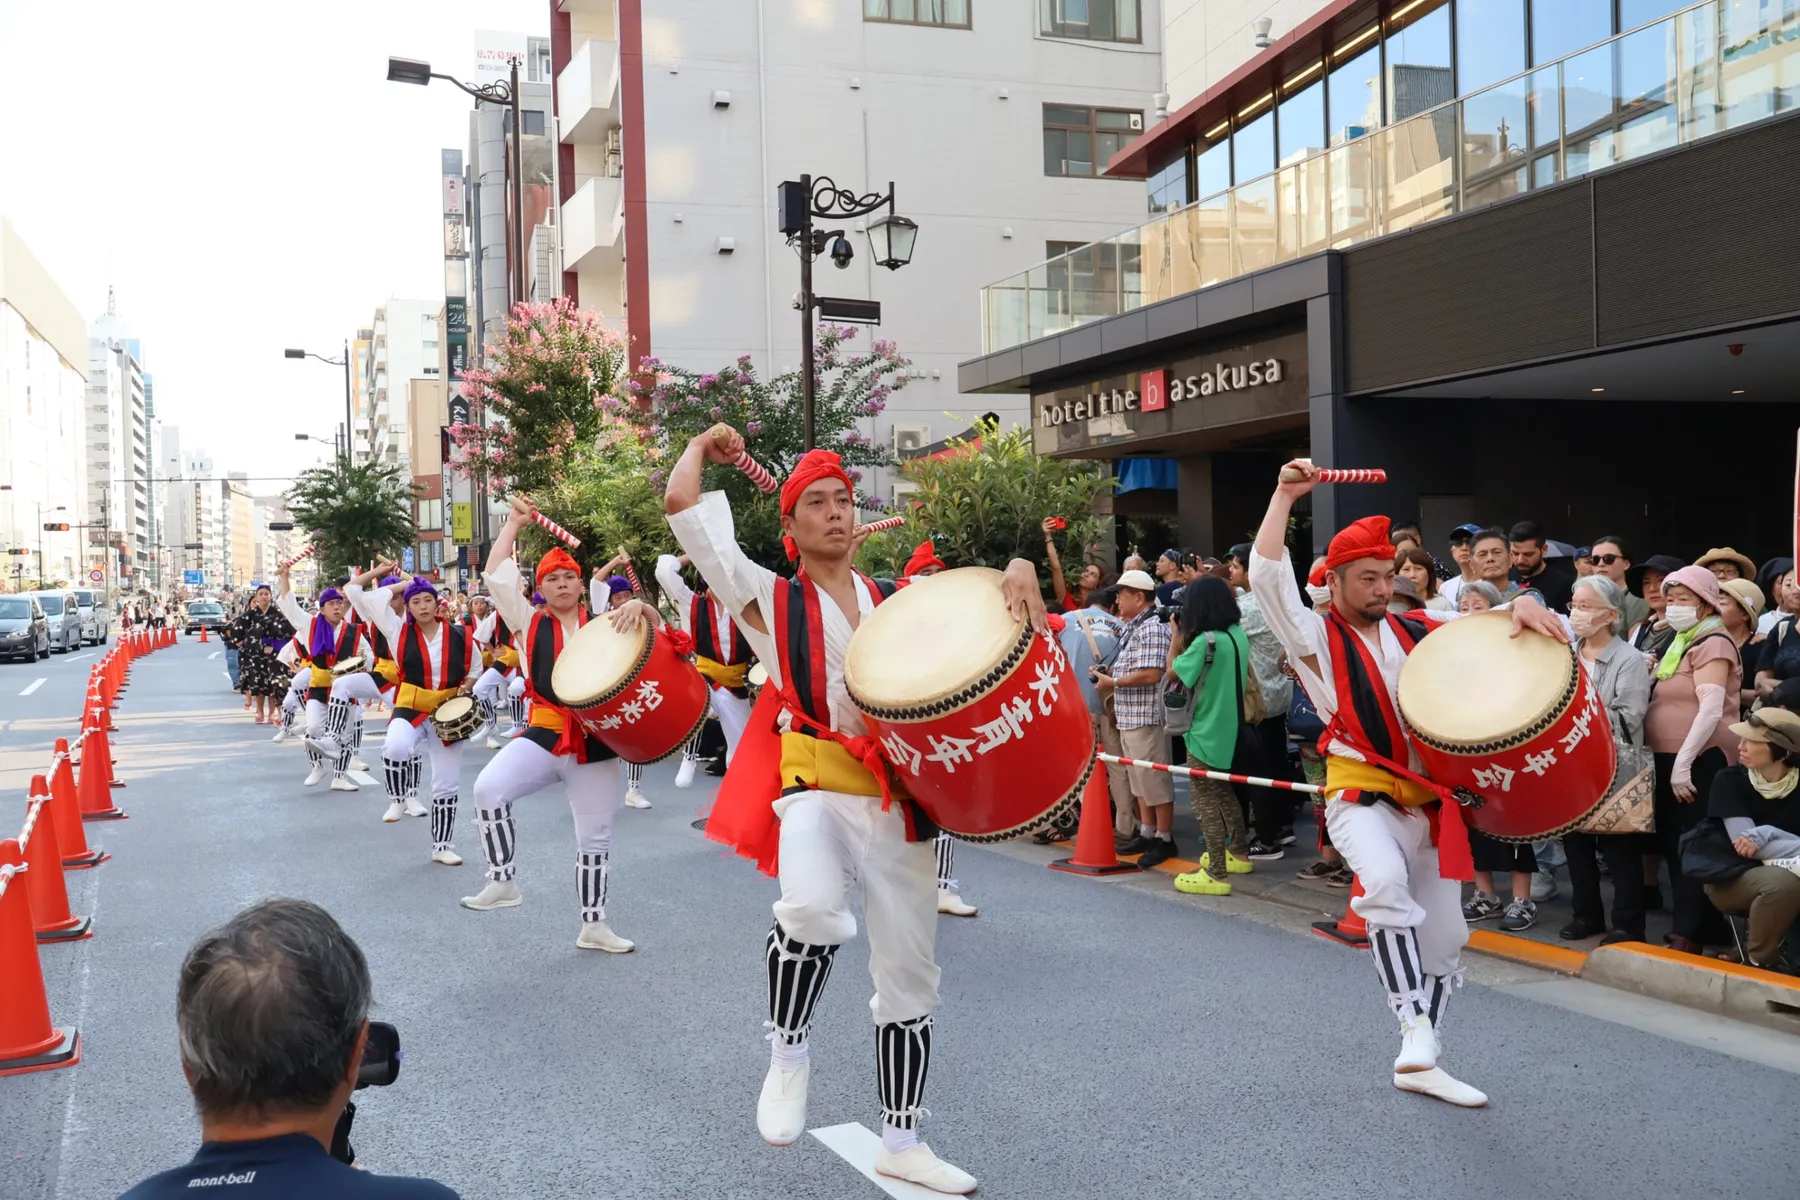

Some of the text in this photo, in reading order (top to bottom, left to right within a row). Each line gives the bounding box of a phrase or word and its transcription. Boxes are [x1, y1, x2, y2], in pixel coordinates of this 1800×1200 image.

[448, 312, 467, 325] 24
[1040, 357, 1282, 428] hotel the b asakusa
[879, 629, 1066, 777] 和光青年会
